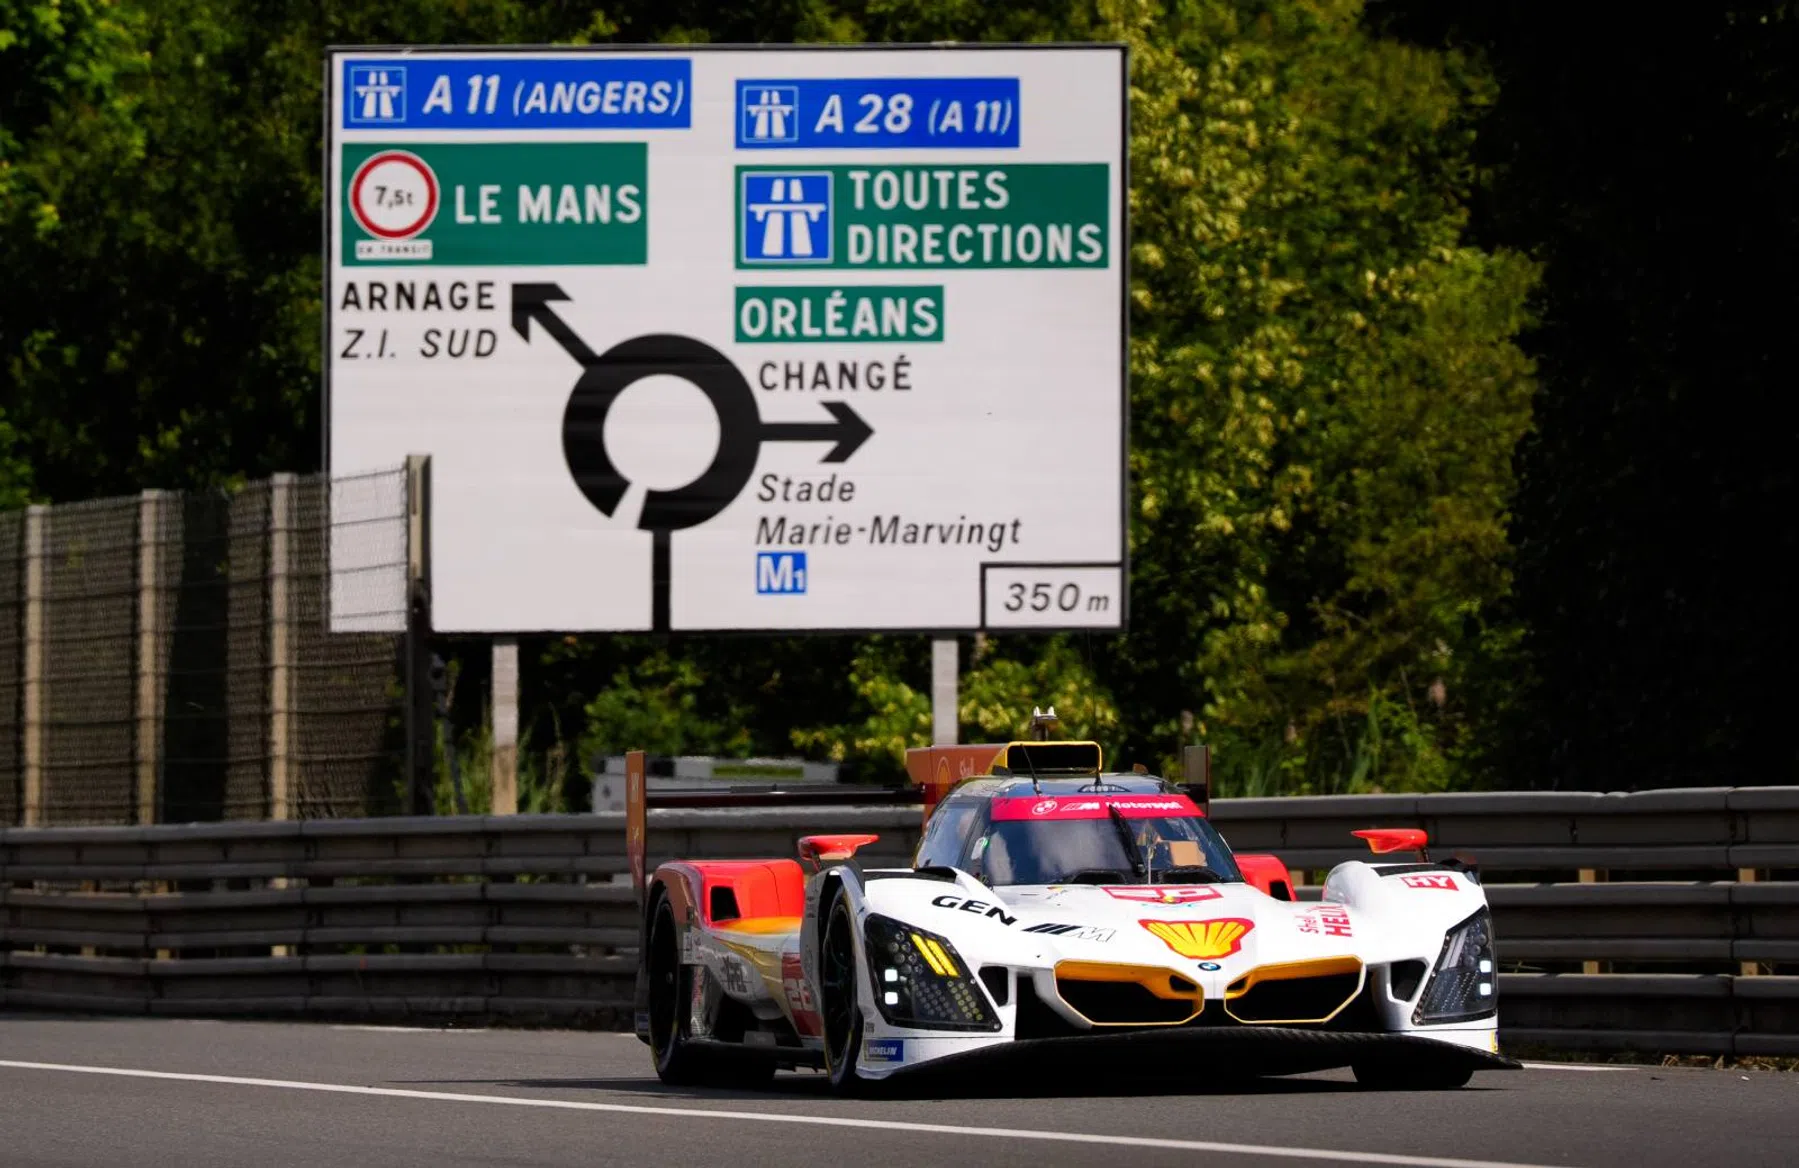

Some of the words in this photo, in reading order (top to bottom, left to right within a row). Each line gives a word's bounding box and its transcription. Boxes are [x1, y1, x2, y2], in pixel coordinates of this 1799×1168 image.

[423, 76, 452, 113] A
[468, 75, 499, 113] 11
[512, 80, 684, 117] (ANGERS)
[815, 95, 843, 132] A
[855, 94, 912, 133] 28
[928, 99, 963, 135] (A
[975, 98, 1012, 135] 11)
[374, 185, 414, 208] 7,5t
[456, 185, 501, 223] LE
[519, 185, 640, 223] MANS
[849, 171, 1008, 209] TOUTES
[849, 224, 1101, 263] DIRECTIONS
[342, 282, 494, 310] ARNAGE
[741, 291, 937, 336] ORLÉANS
[341, 330, 394, 358] Z.I.
[421, 329, 496, 358] SUD
[760, 355, 911, 390] CHANGÉ
[758, 474, 854, 502] Stade
[756, 515, 1021, 552] Marie-Marvingt
[1005, 583, 1079, 611] 350
[1088, 596, 1109, 611] m
[1407, 876, 1449, 888] HY
[932, 895, 1018, 926] GEN
